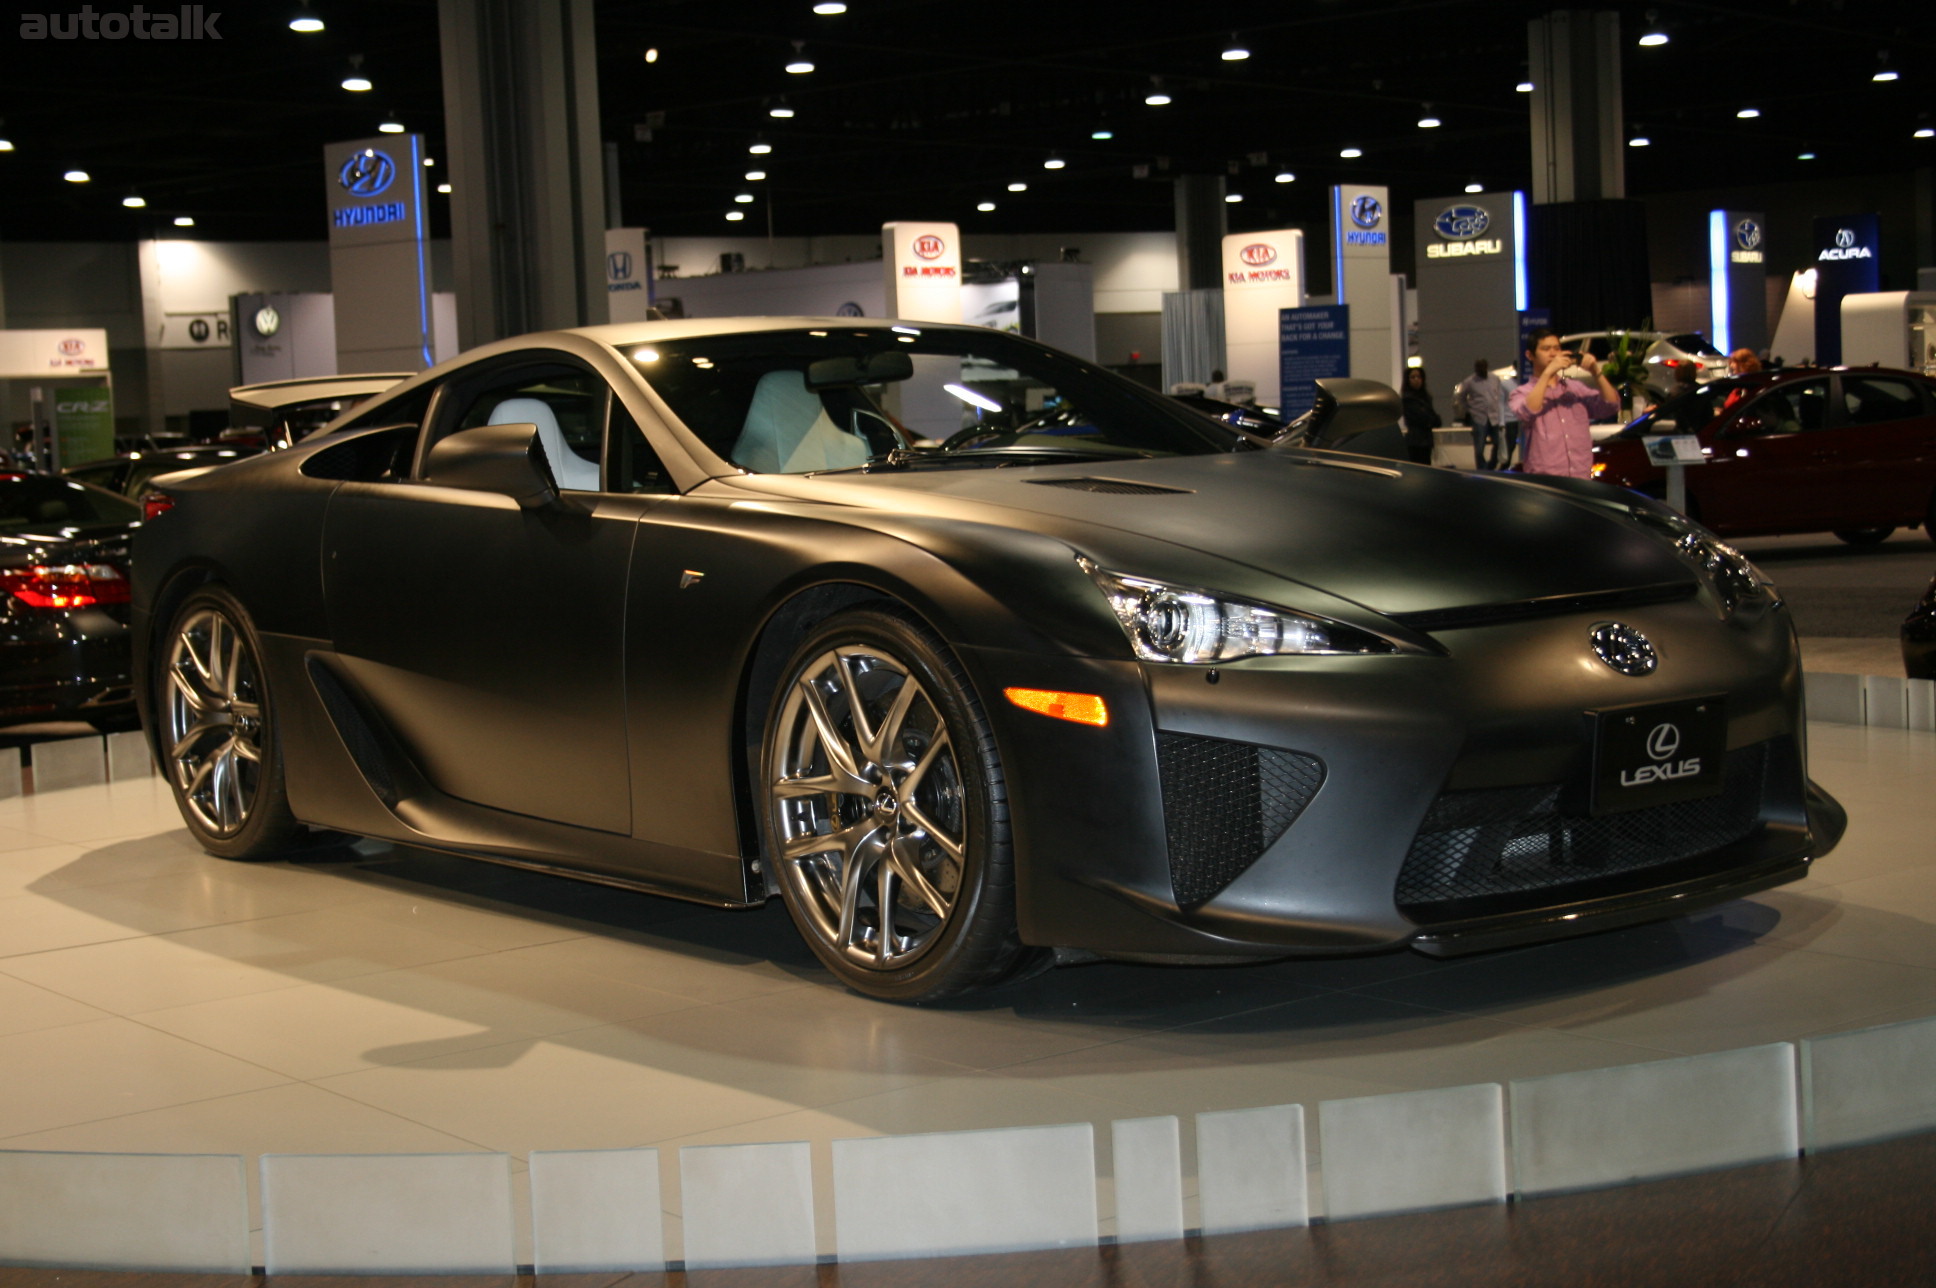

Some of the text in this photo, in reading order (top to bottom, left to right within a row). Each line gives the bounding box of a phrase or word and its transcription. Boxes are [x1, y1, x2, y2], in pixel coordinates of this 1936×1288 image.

[333, 201, 406, 227] HYUNDAI
[1347, 231, 1387, 245] HYUNDAI
[920, 240, 940, 252] KIA
[1426, 239, 1502, 258] SUBARU
[1246, 247, 1270, 262] KIA
[1731, 251, 1763, 263] SUBARU
[1818, 247, 1872, 260] ACURA
[903, 266, 918, 276] KIA
[1228, 269, 1290, 284] KIA MOTORS
[1620, 757, 1701, 787] LEXUS
